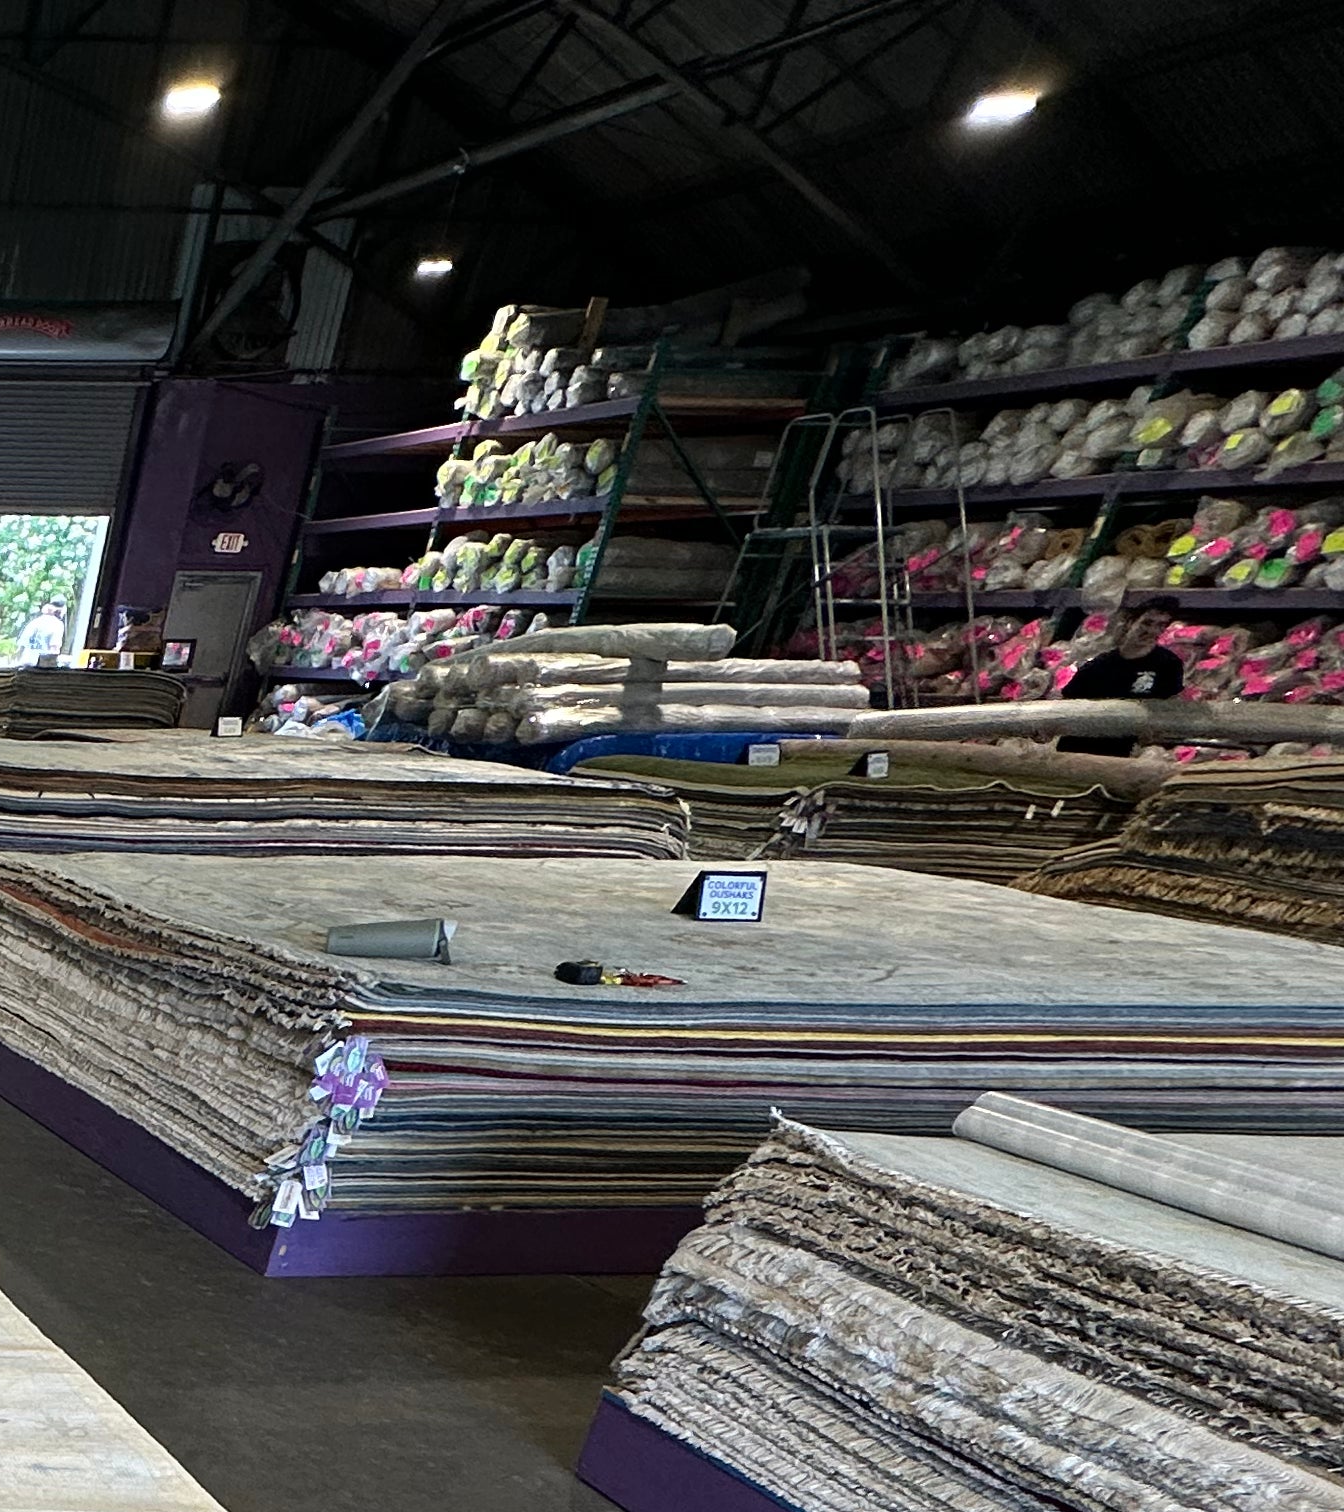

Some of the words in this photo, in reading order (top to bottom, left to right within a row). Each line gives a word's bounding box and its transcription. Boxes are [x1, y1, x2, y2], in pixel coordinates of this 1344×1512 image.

[221, 534, 241, 550] EXIT
[707, 881, 758, 891] COLORFUL
[709, 890, 754, 900] OUSHAKS
[711, 901, 749, 915] 9X12
